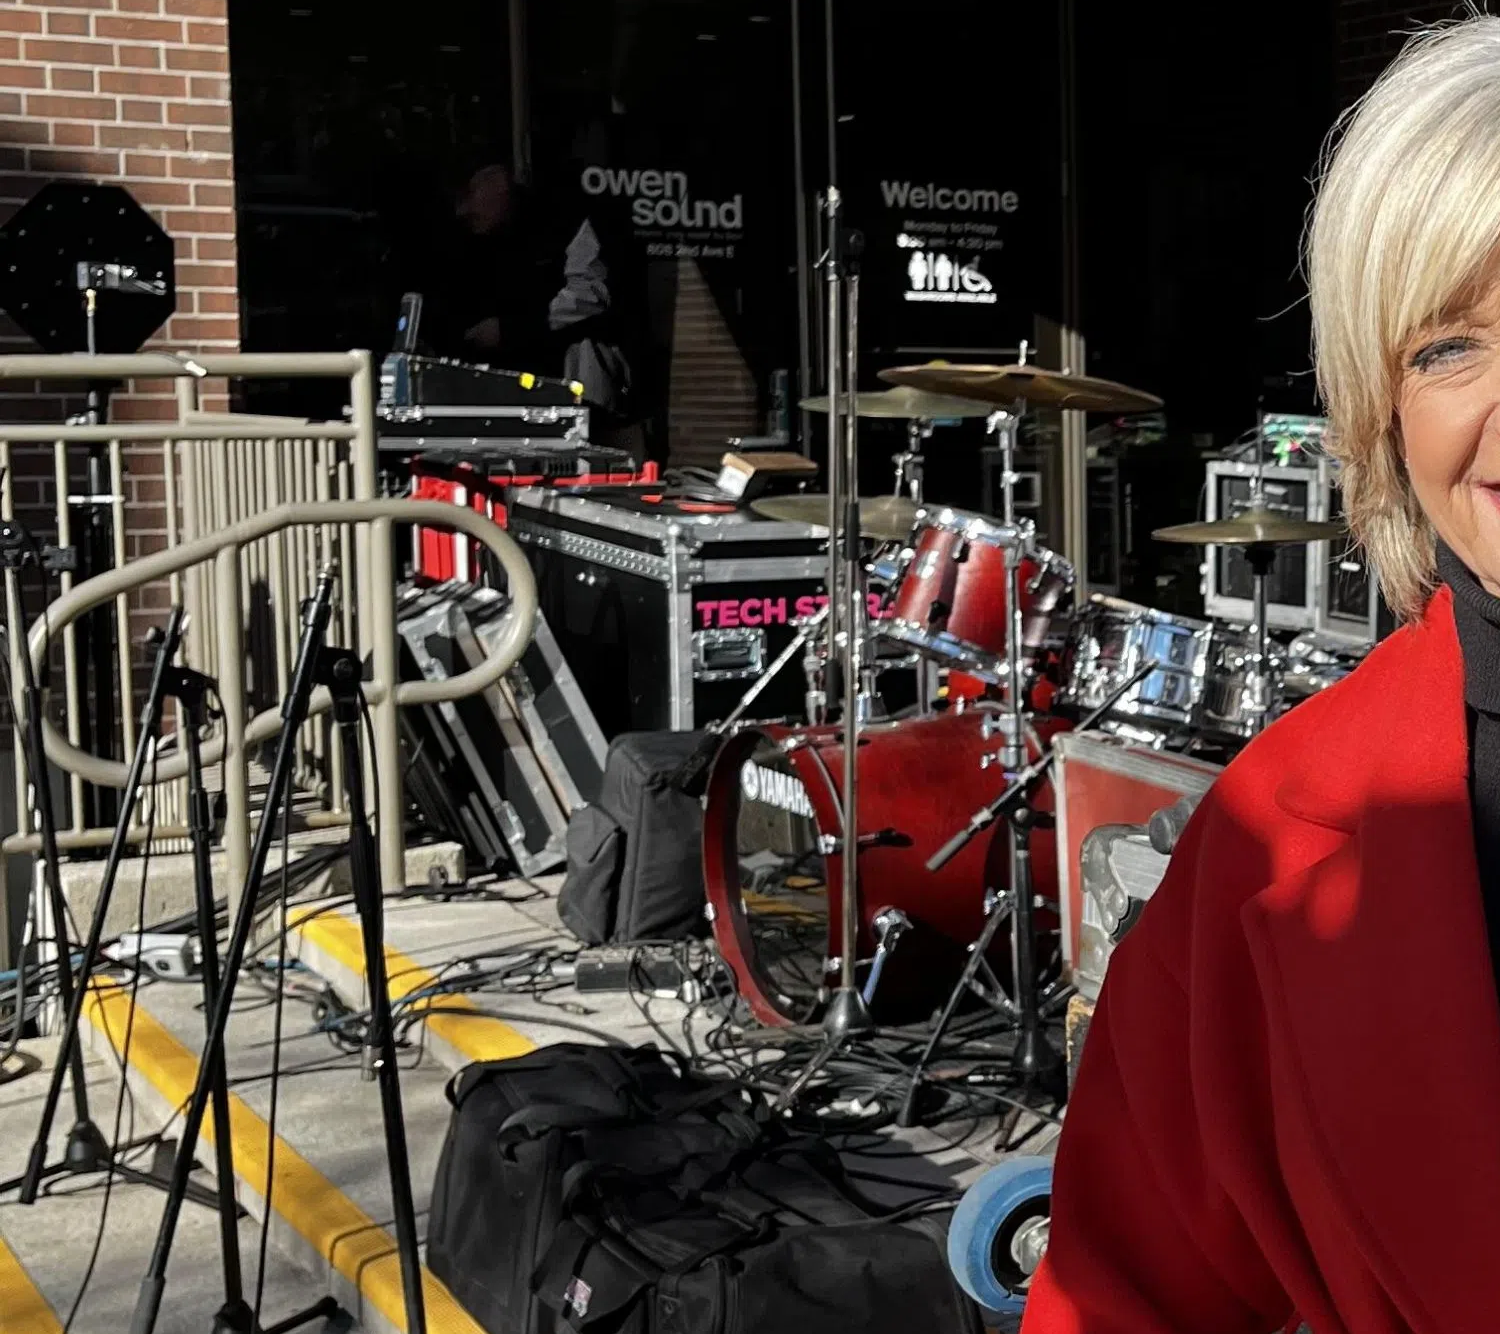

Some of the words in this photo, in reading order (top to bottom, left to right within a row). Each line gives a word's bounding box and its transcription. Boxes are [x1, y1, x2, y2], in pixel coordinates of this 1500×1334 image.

[581, 165, 688, 203] owen
[880, 179, 1019, 214] Welcome
[632, 193, 743, 229] sound
[696, 596, 787, 627] TECH
